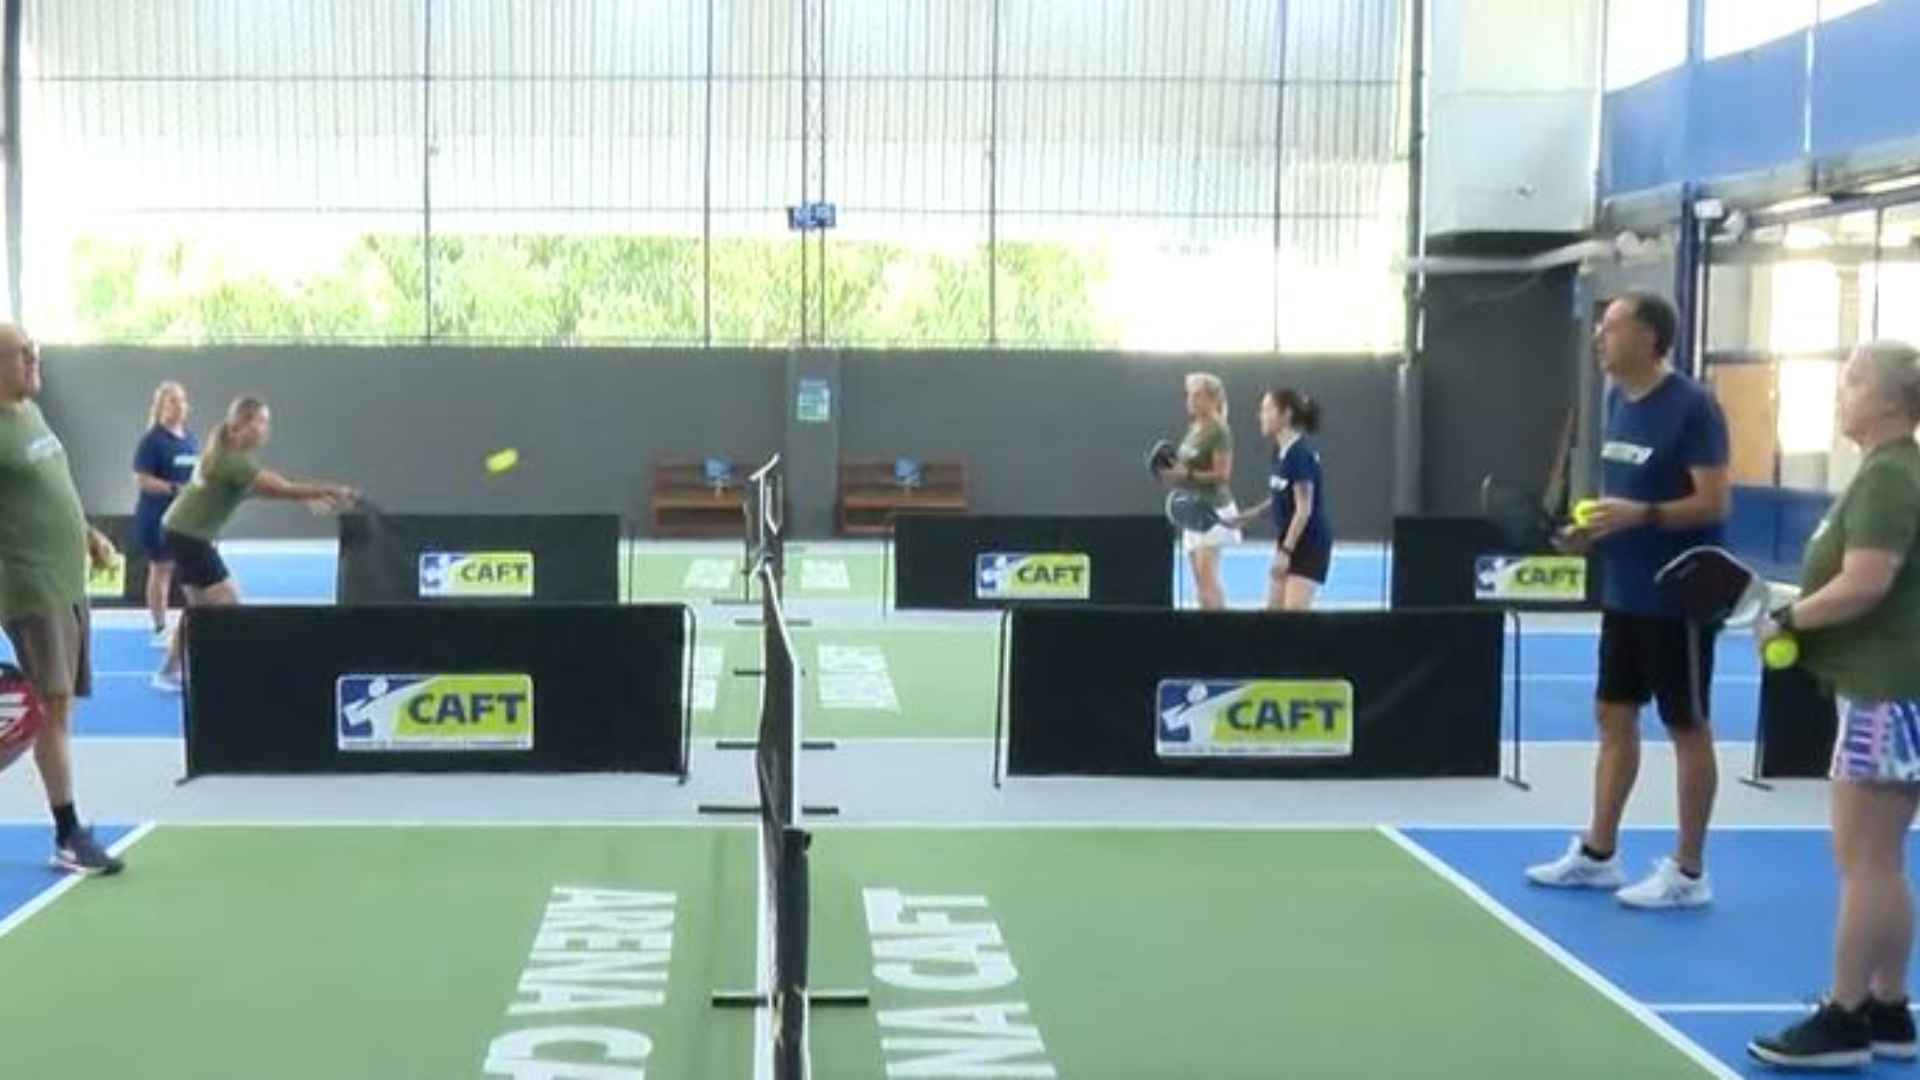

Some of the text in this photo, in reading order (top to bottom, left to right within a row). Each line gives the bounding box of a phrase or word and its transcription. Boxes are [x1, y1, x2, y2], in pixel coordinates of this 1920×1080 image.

[461, 562, 528, 583] CAFT
[1017, 564, 1085, 584] CAFT
[1515, 567, 1582, 586] CAFT
[407, 692, 526, 725] CAFT
[1226, 698, 1344, 732] CAFT
[506, 886, 677, 1016] ARENA
[863, 887, 1018, 991] CAFT
